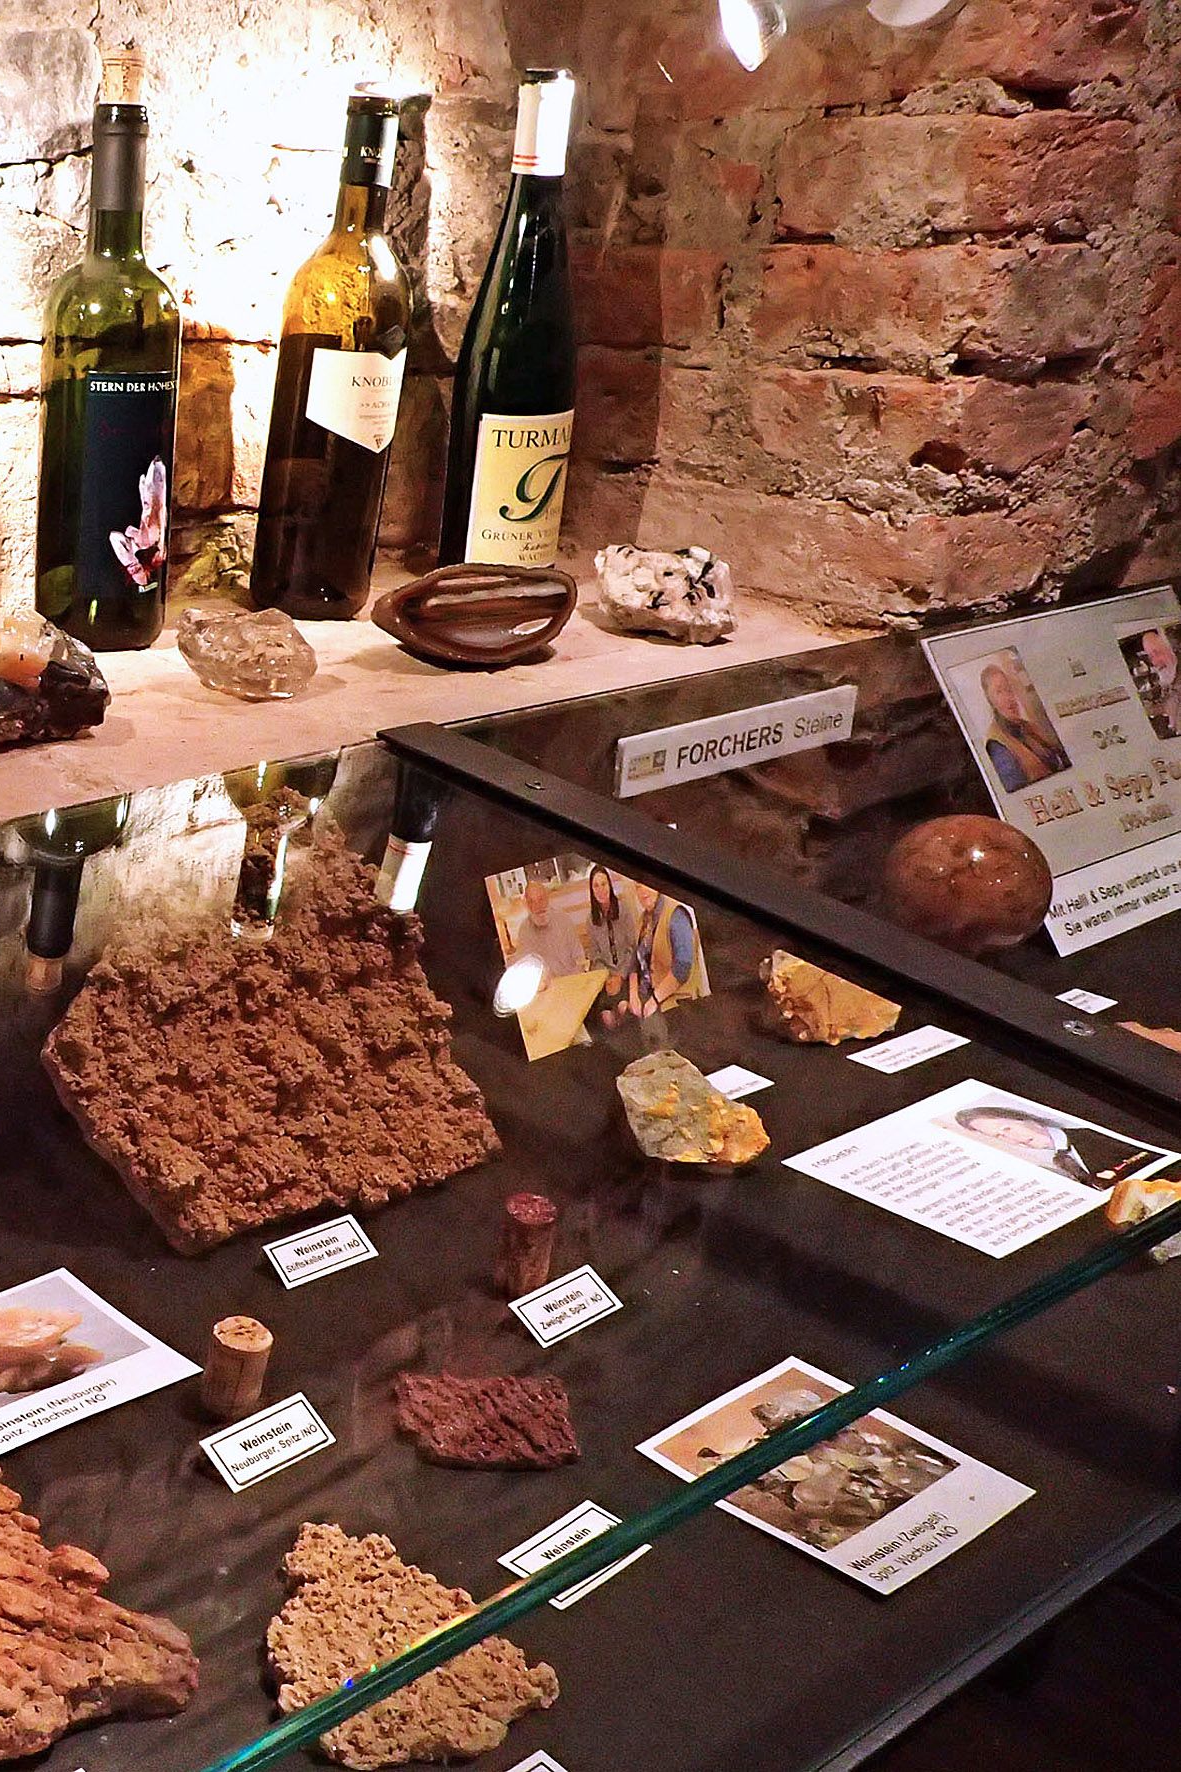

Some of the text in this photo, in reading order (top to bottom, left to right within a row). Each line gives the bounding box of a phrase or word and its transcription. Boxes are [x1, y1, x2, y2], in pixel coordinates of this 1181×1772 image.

[90, 381, 124, 392] STERN
[126, 382, 146, 393] DER
[676, 722, 784, 768] FORCHERS
[793, 711, 843, 739] Steine
[1064, 921, 1083, 936] Sie
[542, 1289, 585, 1314] Weinstein
[29, 1404, 79, 1430] Wachau
[239, 1421, 293, 1452] Weinstein
[278, 1433, 302, 1449] Spitz
[540, 1527, 592, 1561] Weinstein
[847, 1539, 903, 1572] Weinstein
